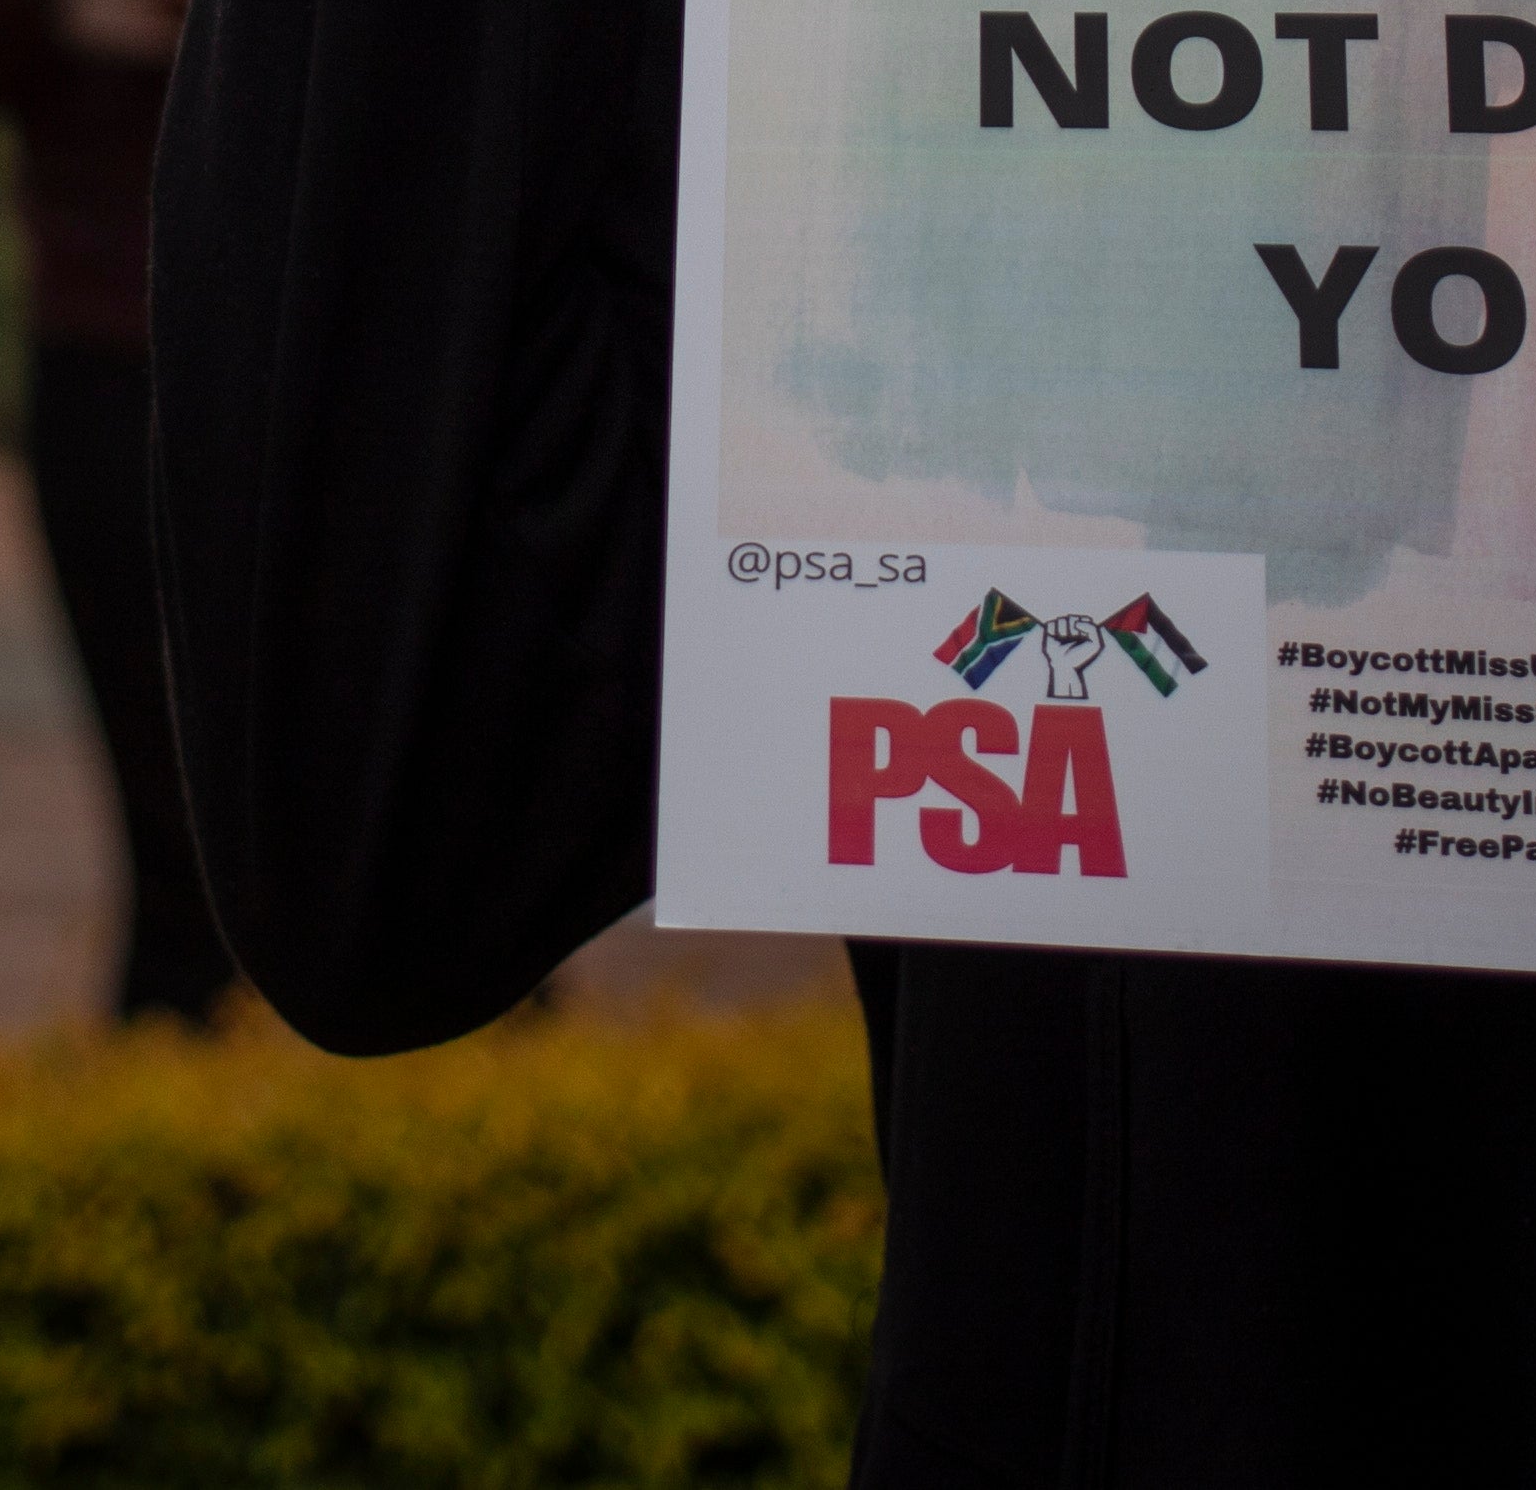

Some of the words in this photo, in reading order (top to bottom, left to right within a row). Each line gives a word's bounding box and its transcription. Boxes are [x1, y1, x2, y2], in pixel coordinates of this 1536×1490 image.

[980, 11, 1378, 132] NOT
[728, 542, 926, 591] @psa_sa
[829, 698, 1126, 877] PSA
